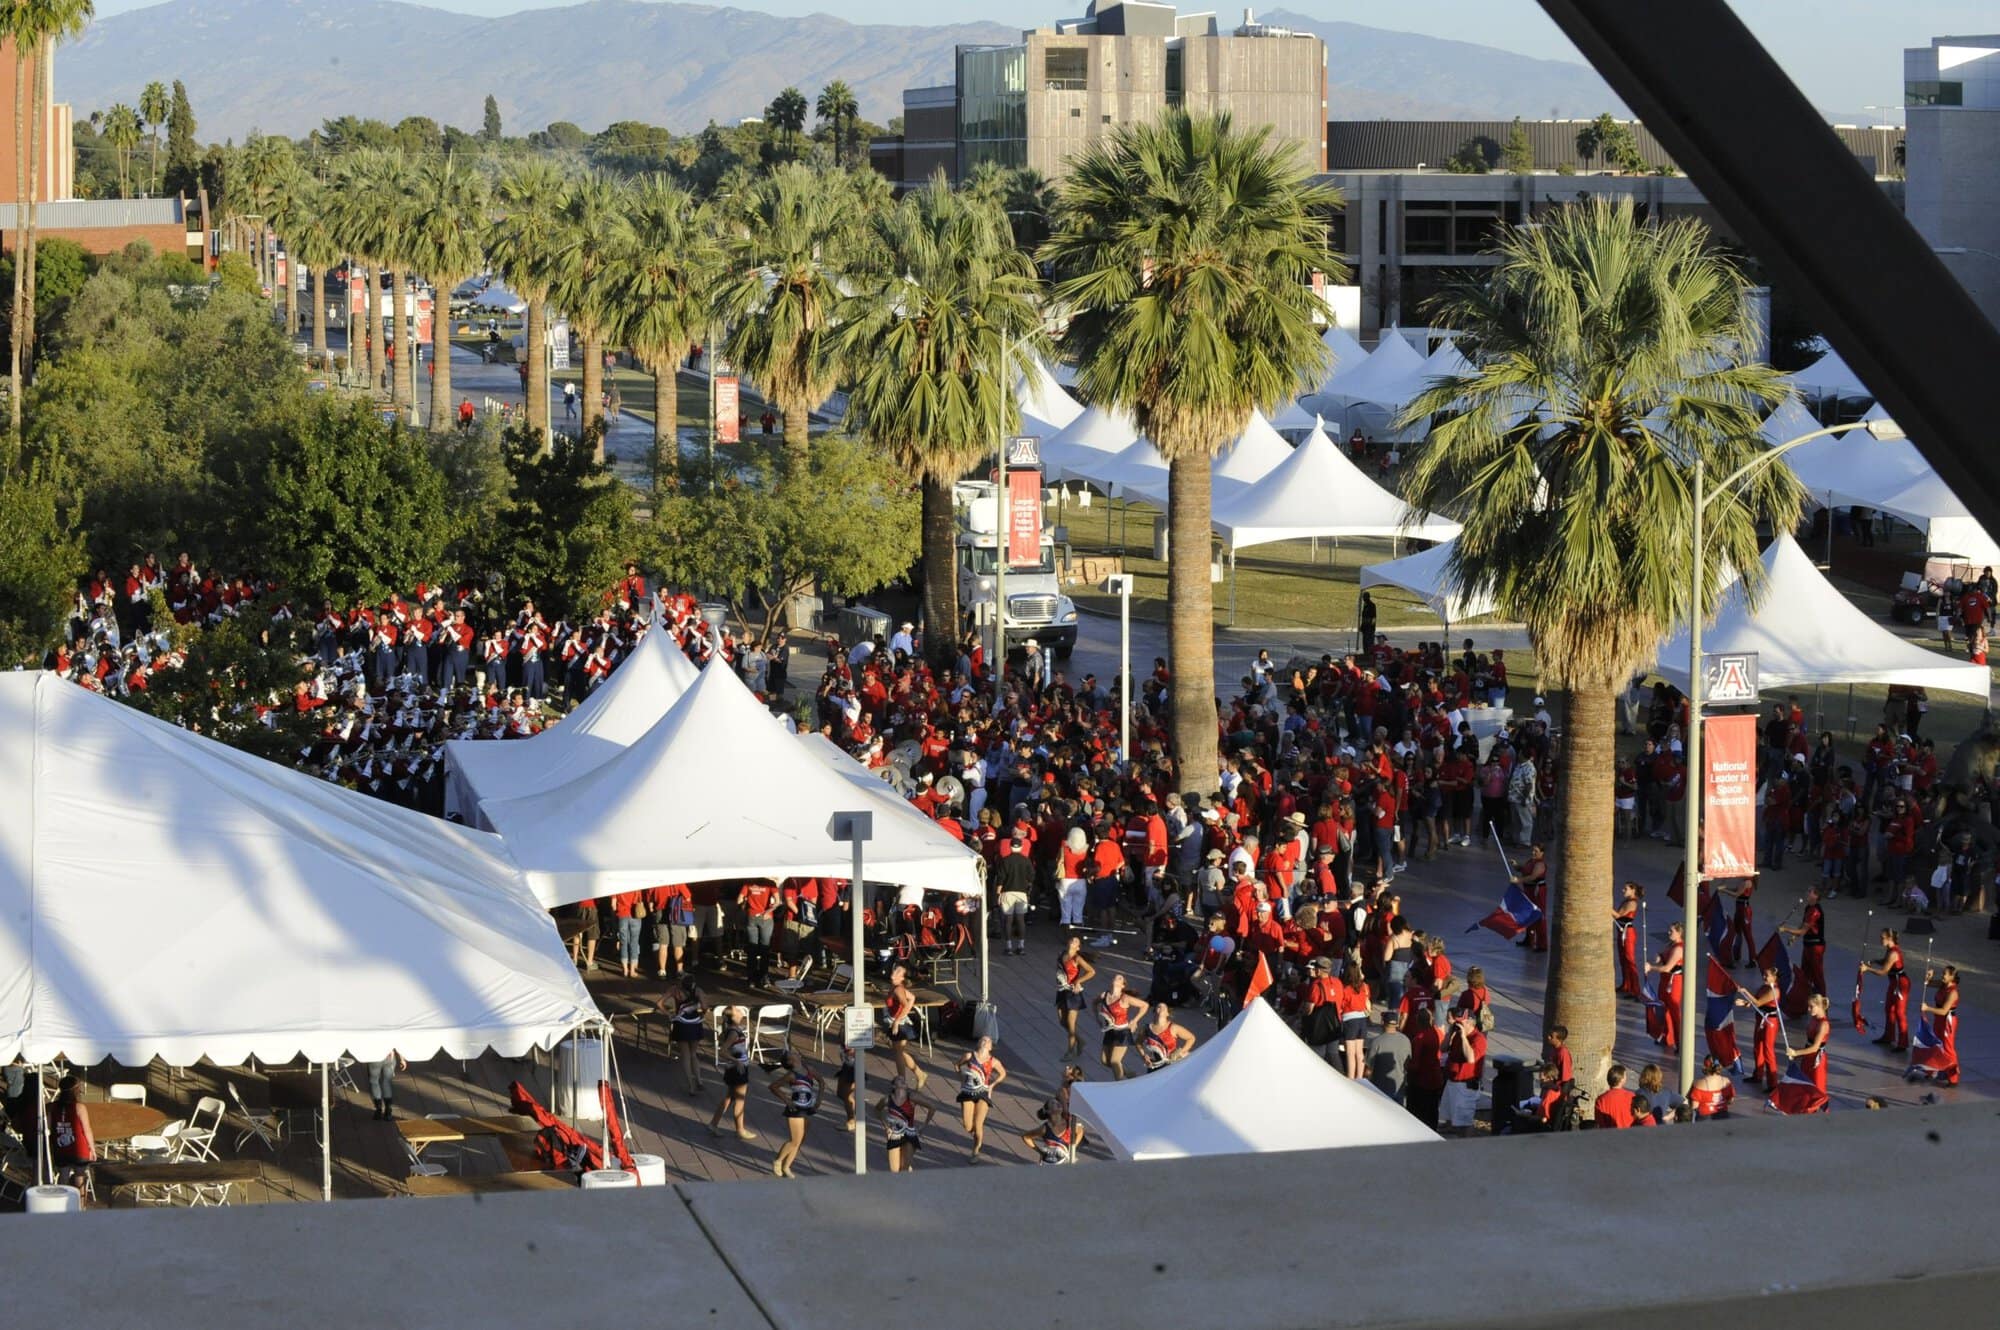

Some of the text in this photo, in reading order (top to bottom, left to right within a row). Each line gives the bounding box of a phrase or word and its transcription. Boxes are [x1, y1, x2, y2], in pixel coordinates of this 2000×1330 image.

[1710, 657, 1755, 700] A
[1712, 760, 1748, 771] National
[1710, 772, 1749, 782] Leader in
[1716, 784, 1743, 795] Space
[1710, 795, 1749, 806] Research
